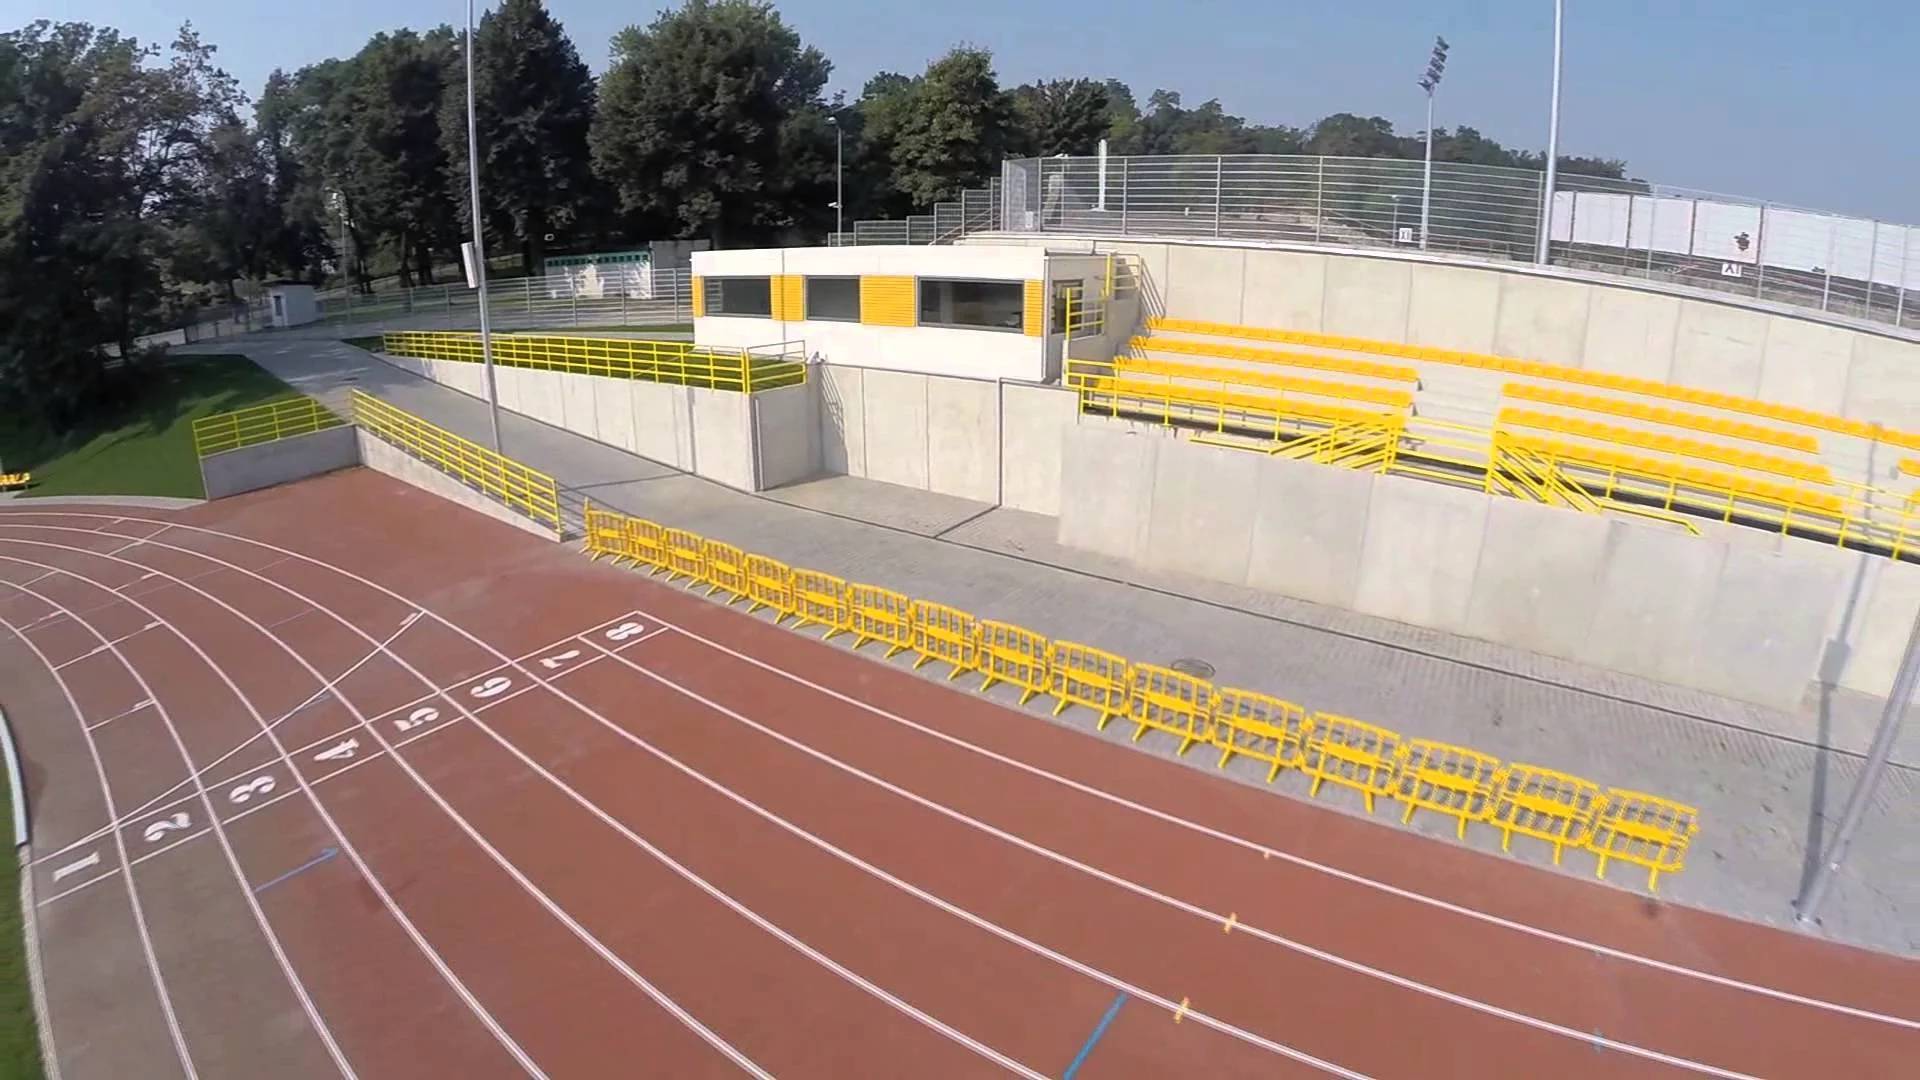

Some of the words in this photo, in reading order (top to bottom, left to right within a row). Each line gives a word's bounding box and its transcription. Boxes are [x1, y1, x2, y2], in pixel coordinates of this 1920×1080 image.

[53, 851, 99, 882] 1
[144, 812, 192, 842] 2
[229, 775, 276, 803] 3
[313, 738, 359, 761] 4
[394, 707, 439, 731] 5
[470, 677, 512, 698] 6
[539, 650, 581, 669] 7
[605, 622, 644, 640] 8
